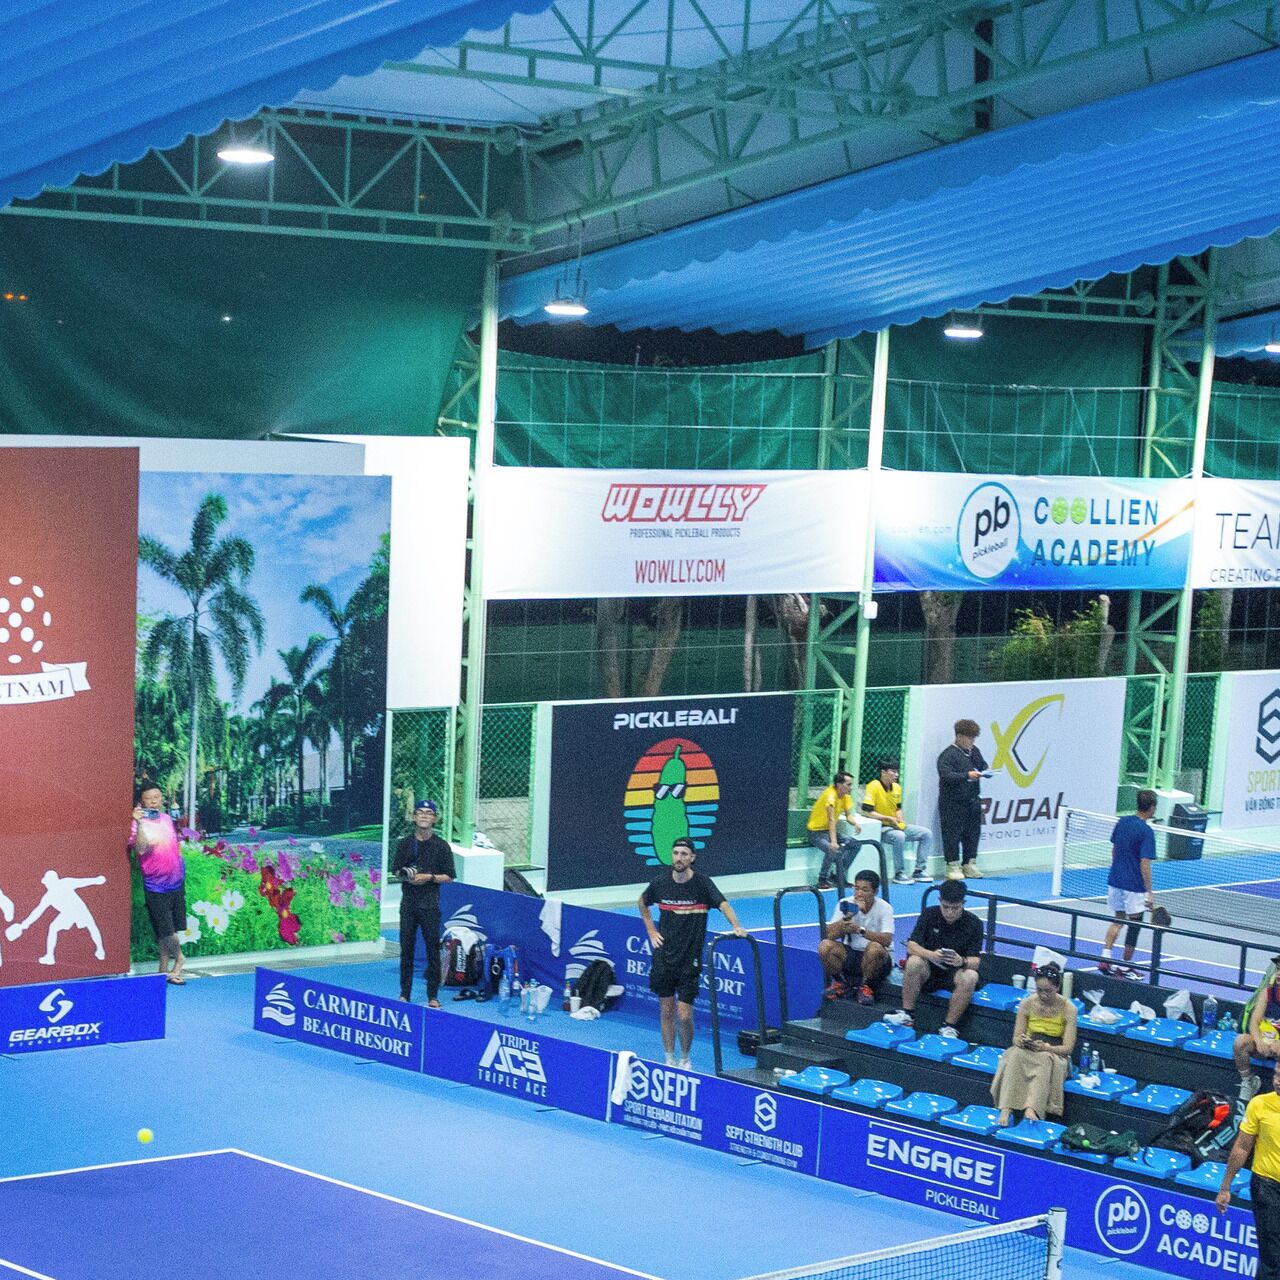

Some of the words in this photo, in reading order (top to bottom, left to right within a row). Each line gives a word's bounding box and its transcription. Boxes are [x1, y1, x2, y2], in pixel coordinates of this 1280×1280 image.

[601, 484, 768, 522] WOWLLY
[629, 528, 673, 538] PROFESSIONAL
[674, 528, 709, 538] PICKLEBALL
[711, 528, 741, 537] PRODUCTS
[973, 496, 1011, 547] pb
[972, 537, 1008, 561] pickleball
[1031, 539, 1156, 566] ACADEMY
[635, 560, 726, 583] WOWLLY.COM
[1210, 568, 1271, 582] CREATING
[981, 828, 1020, 841] EYOND
[303, 988, 412, 1033] CARMELINA
[9, 1022, 101, 1042] GEARBOX
[302, 1016, 351, 1042] BEACH
[354, 1028, 413, 1058] RESORT
[500, 1032, 540, 1054] TRIPLE
[478, 1068, 518, 1089] TRIPLE
[525, 1081, 547, 1098] ACE
[651, 1068, 700, 1111] SEPT
[725, 1125, 744, 1141] SEPT
[744, 1130, 783, 1152] STRENGTH
[783, 1141, 803, 1157] CLUB
[867, 1133, 996, 1186] ENGAGE
[925, 1188, 1000, 1220] PICKLEBALL
[1107, 1195, 1141, 1228] pb
[1106, 1226, 1137, 1236] pickleball
[1159, 1204, 1259, 1249] COOLLIE
[1156, 1233, 1258, 1278] ACADEM
